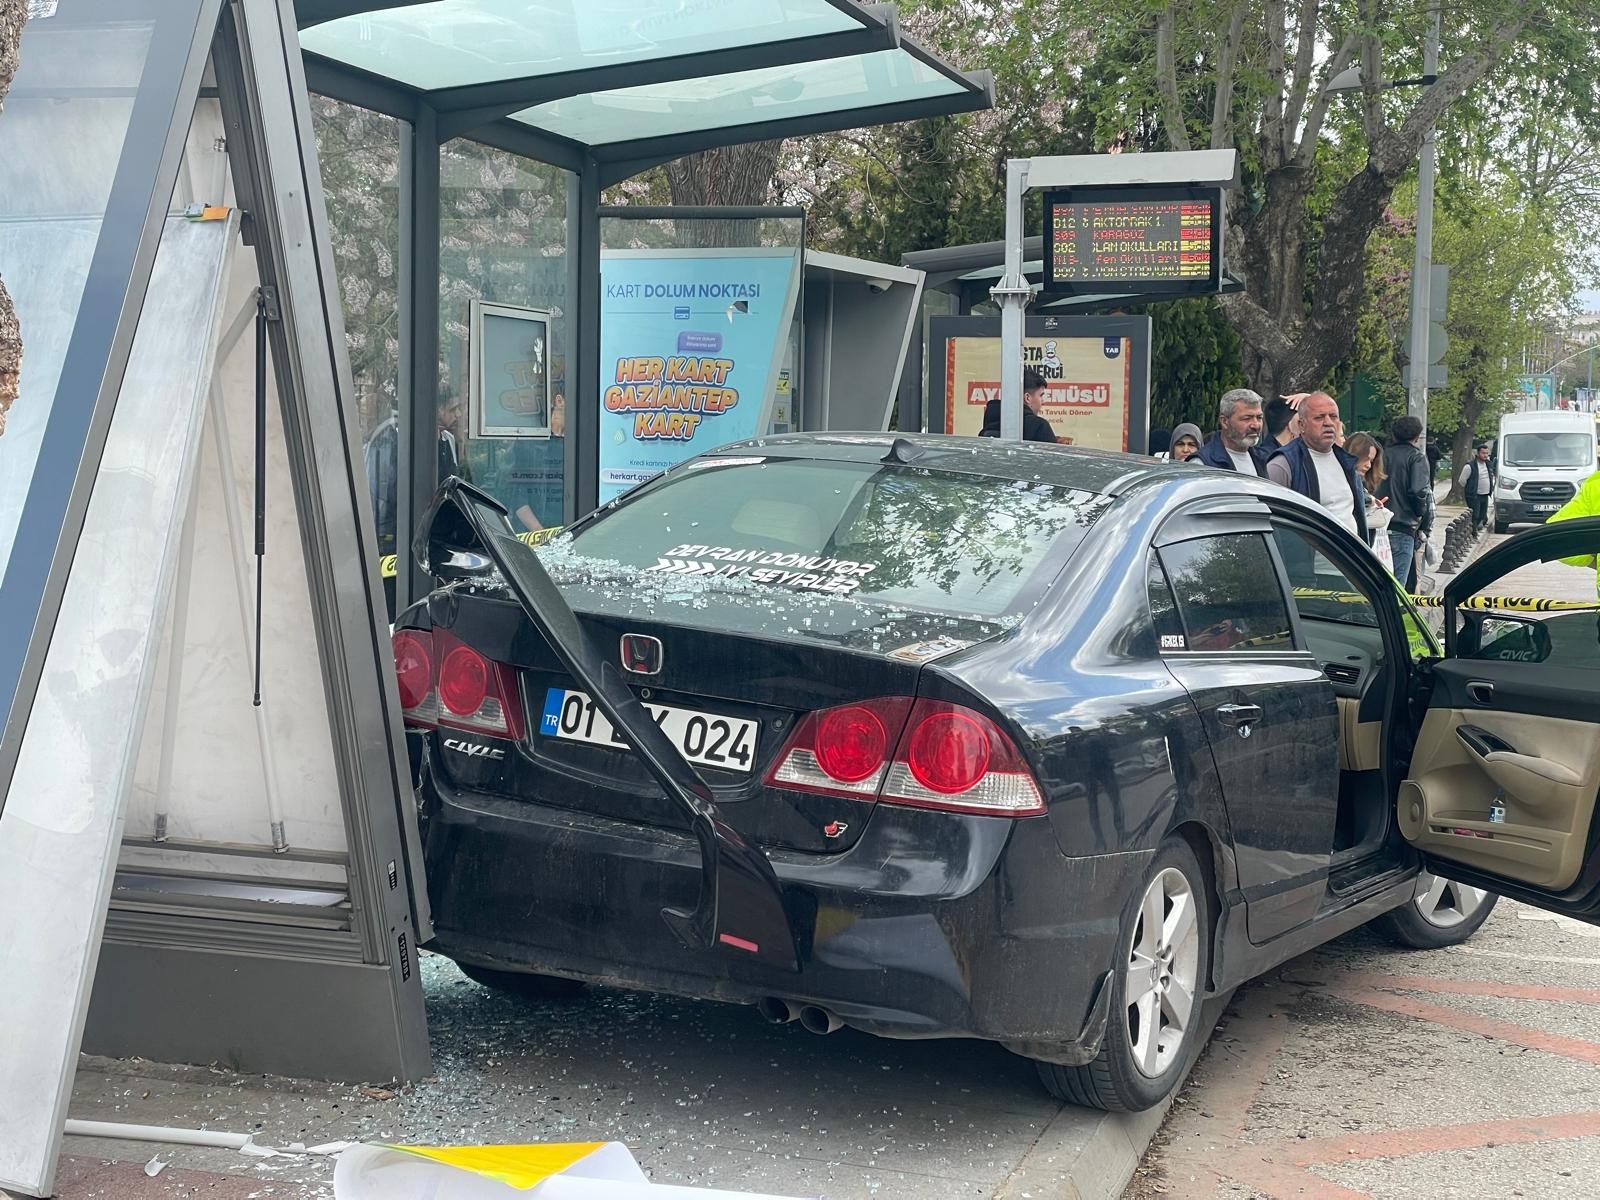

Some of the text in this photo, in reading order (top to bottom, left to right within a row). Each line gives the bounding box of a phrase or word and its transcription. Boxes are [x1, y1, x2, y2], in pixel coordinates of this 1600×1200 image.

[607, 283, 760, 298] KART DOLUM NOKTASI
[615, 356, 733, 384] HER KART
[604, 378, 738, 413] GAZİANTEP
[1042, 385, 1108, 404] ENÜSÜ
[634, 412, 702, 439] KART
[664, 544, 766, 563] DEVRAN
[1499, 650, 1530, 661] CIVIC
[545, 714, 558, 727] TR
[560, 695, 597, 738] 01
[443, 738, 505, 760] CIVIC
[683, 715, 751, 766] 024
